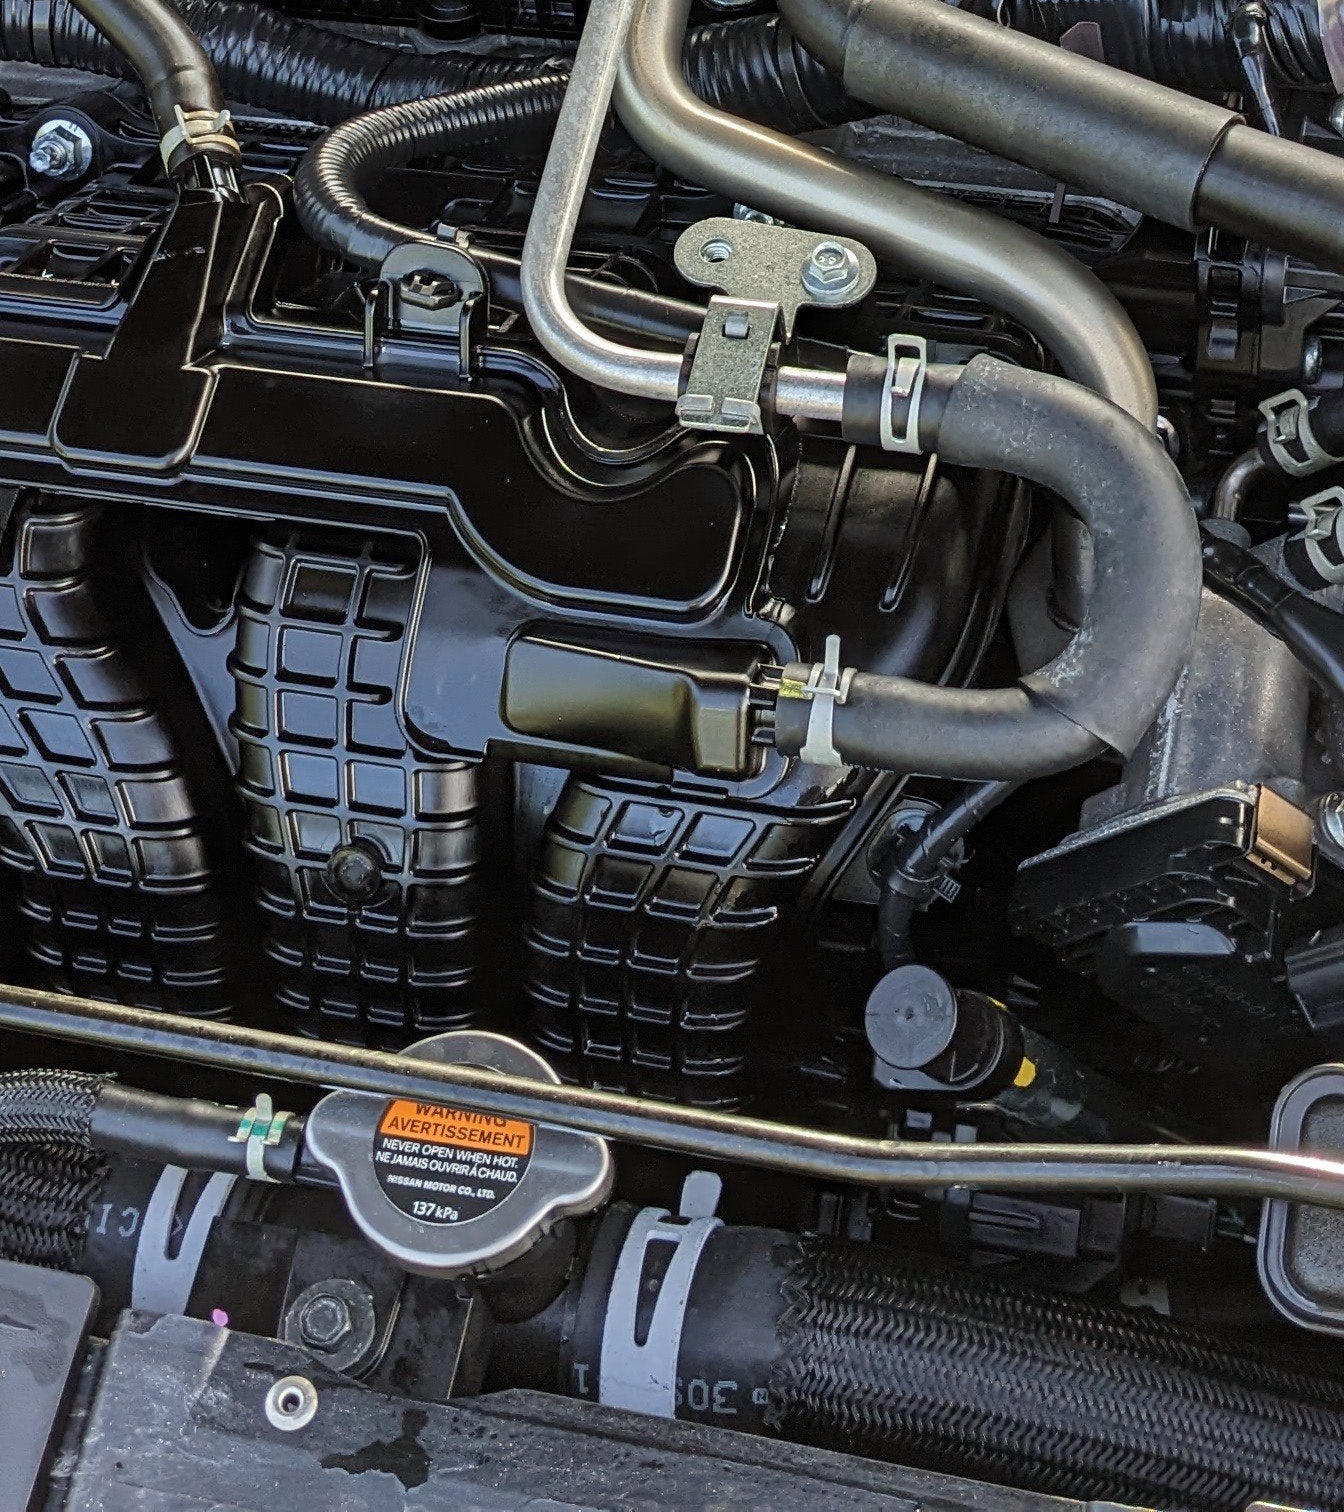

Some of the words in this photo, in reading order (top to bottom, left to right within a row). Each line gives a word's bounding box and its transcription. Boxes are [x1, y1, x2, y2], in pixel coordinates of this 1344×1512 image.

[416, 1103, 507, 1128] WARNING
[388, 1115, 526, 1149] AVERTISSEMENT
[376, 1150, 391, 1162] NE
[391, 1153, 429, 1169] JAMAIS
[429, 1159, 470, 1176] OUVRIR
[478, 1167, 518, 1183] CHAUD.
[382, 1138, 420, 1154] NEVER
[422, 1144, 454, 1159] OPEN
[456, 1149, 491, 1165] WHEN
[492, 1155, 519, 1169] HOT.
[387, 1174, 423, 1188] NISSAN
[423, 1180, 457, 1194] MOTOR
[413, 1200, 437, 1217] 137
[436, 1205, 459, 1221] kPa
